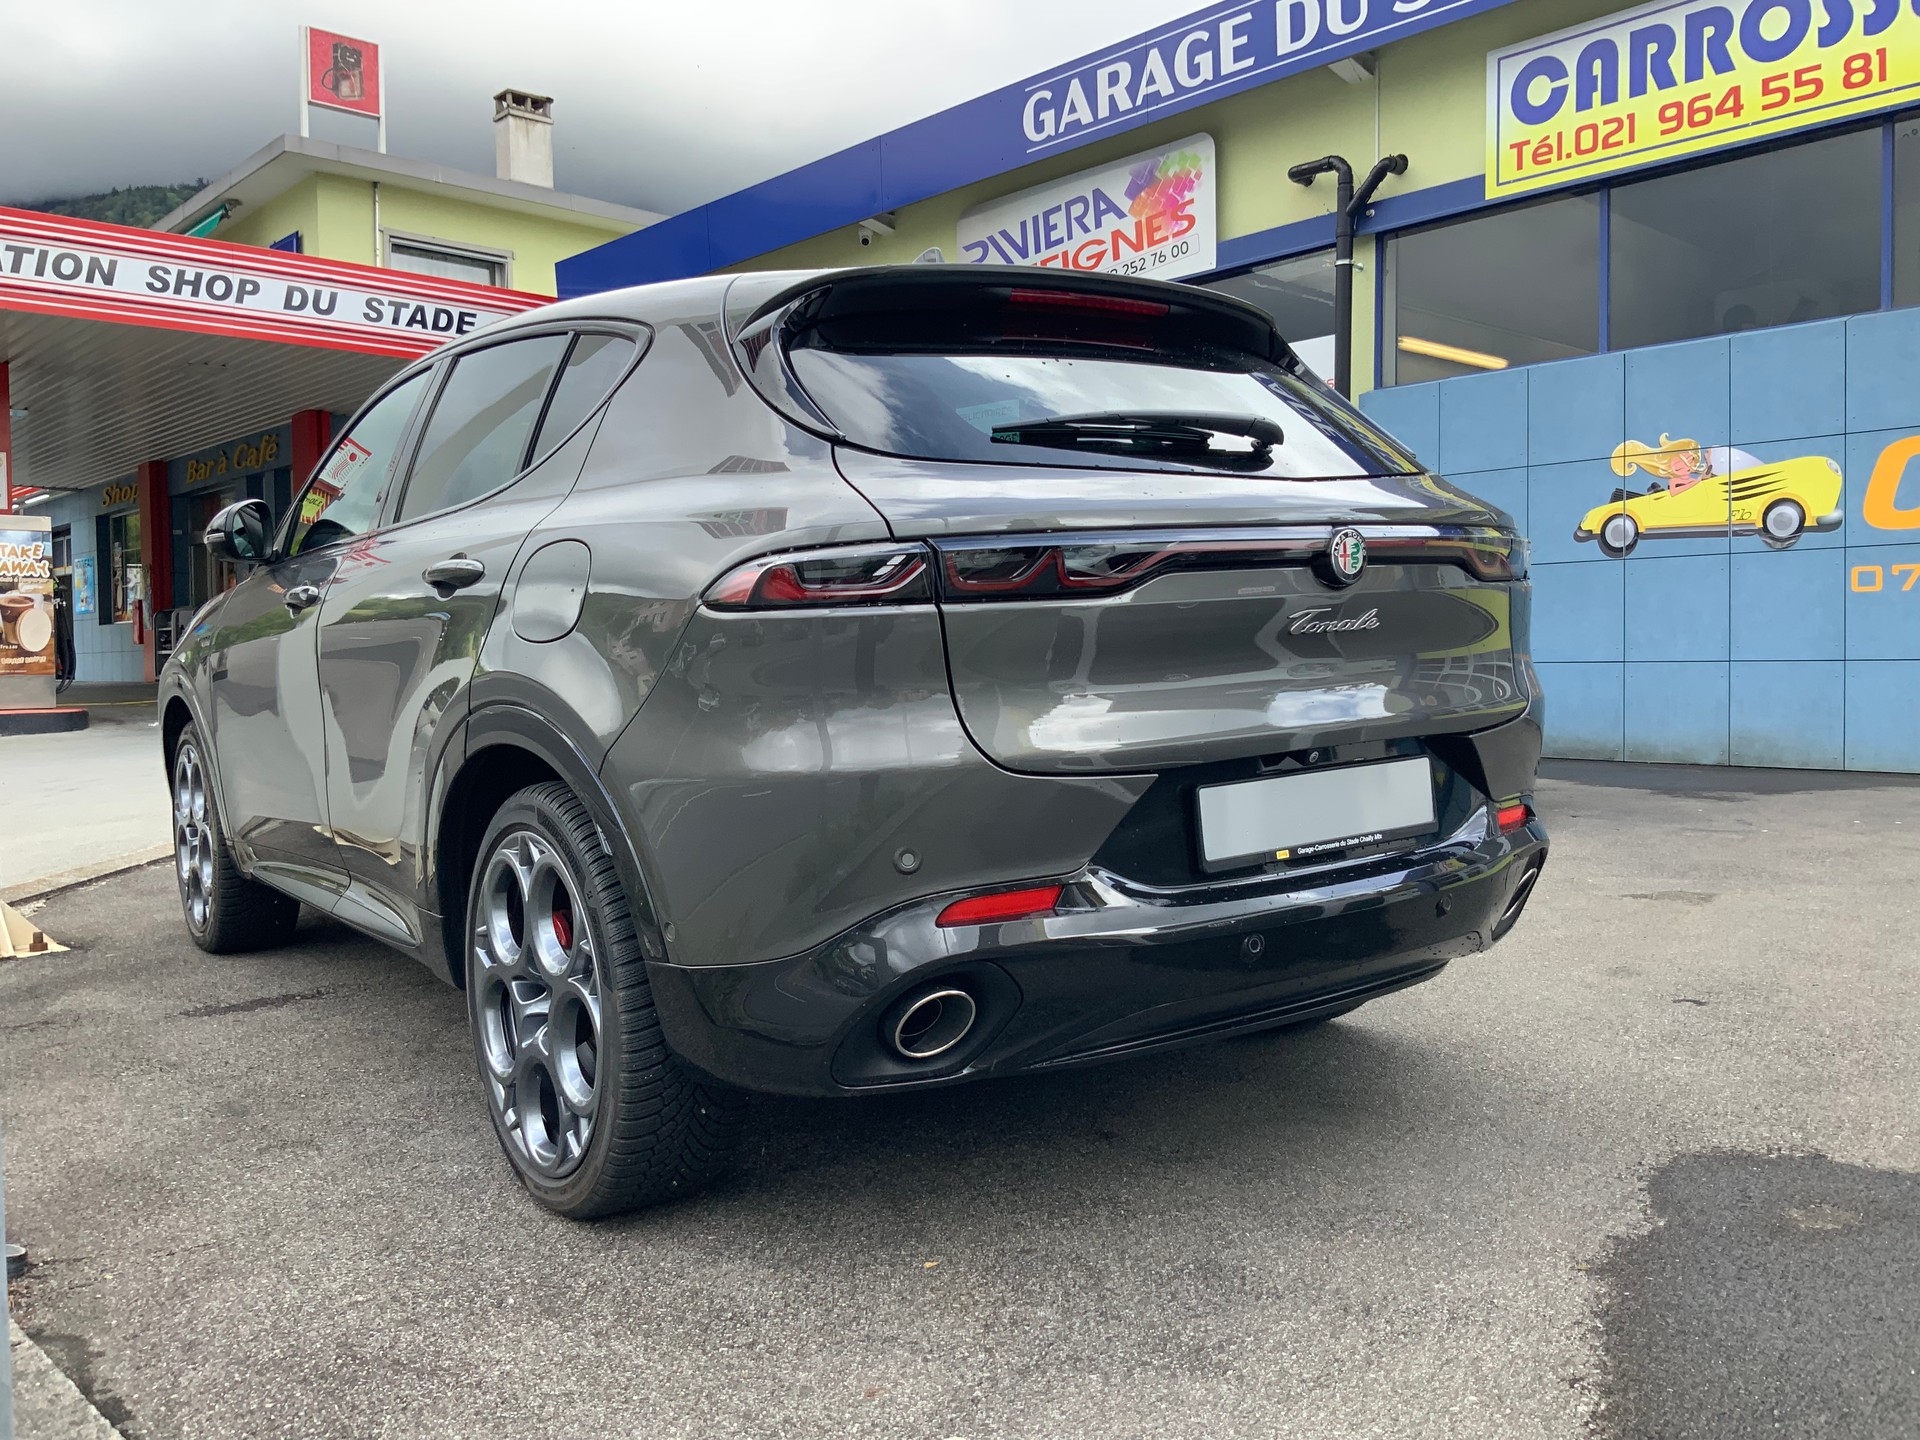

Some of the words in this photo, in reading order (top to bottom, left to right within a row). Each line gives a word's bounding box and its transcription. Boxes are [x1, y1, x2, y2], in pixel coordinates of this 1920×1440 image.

[1022, 12, 1255, 142] GARAGE
[1276, 0, 1368, 56] DU
[1511, 0, 1920, 125] CARROS
[1510, 113, 1635, 171] Tél.021
[1658, 85, 1744, 136] 964
[1762, 63, 1824, 111] 55
[1842, 48, 1887, 90] 81
[1122, 257, 1146, 275] 252
[1150, 250, 1167, 267] 76
[1171, 241, 1189, 258] 00
[0, 244, 118, 287] TION
[145, 265, 260, 304] SHOP
[283, 285, 338, 316] DU
[362, 297, 477, 335] STADE
[186, 459, 215, 484] Bar
[217, 450, 228, 474] à
[233, 434, 279, 469] Café
[0, 543, 43, 559] TAKE
[0, 560, 48, 577] AWAY
[1287, 607, 1380, 635] Tonale
